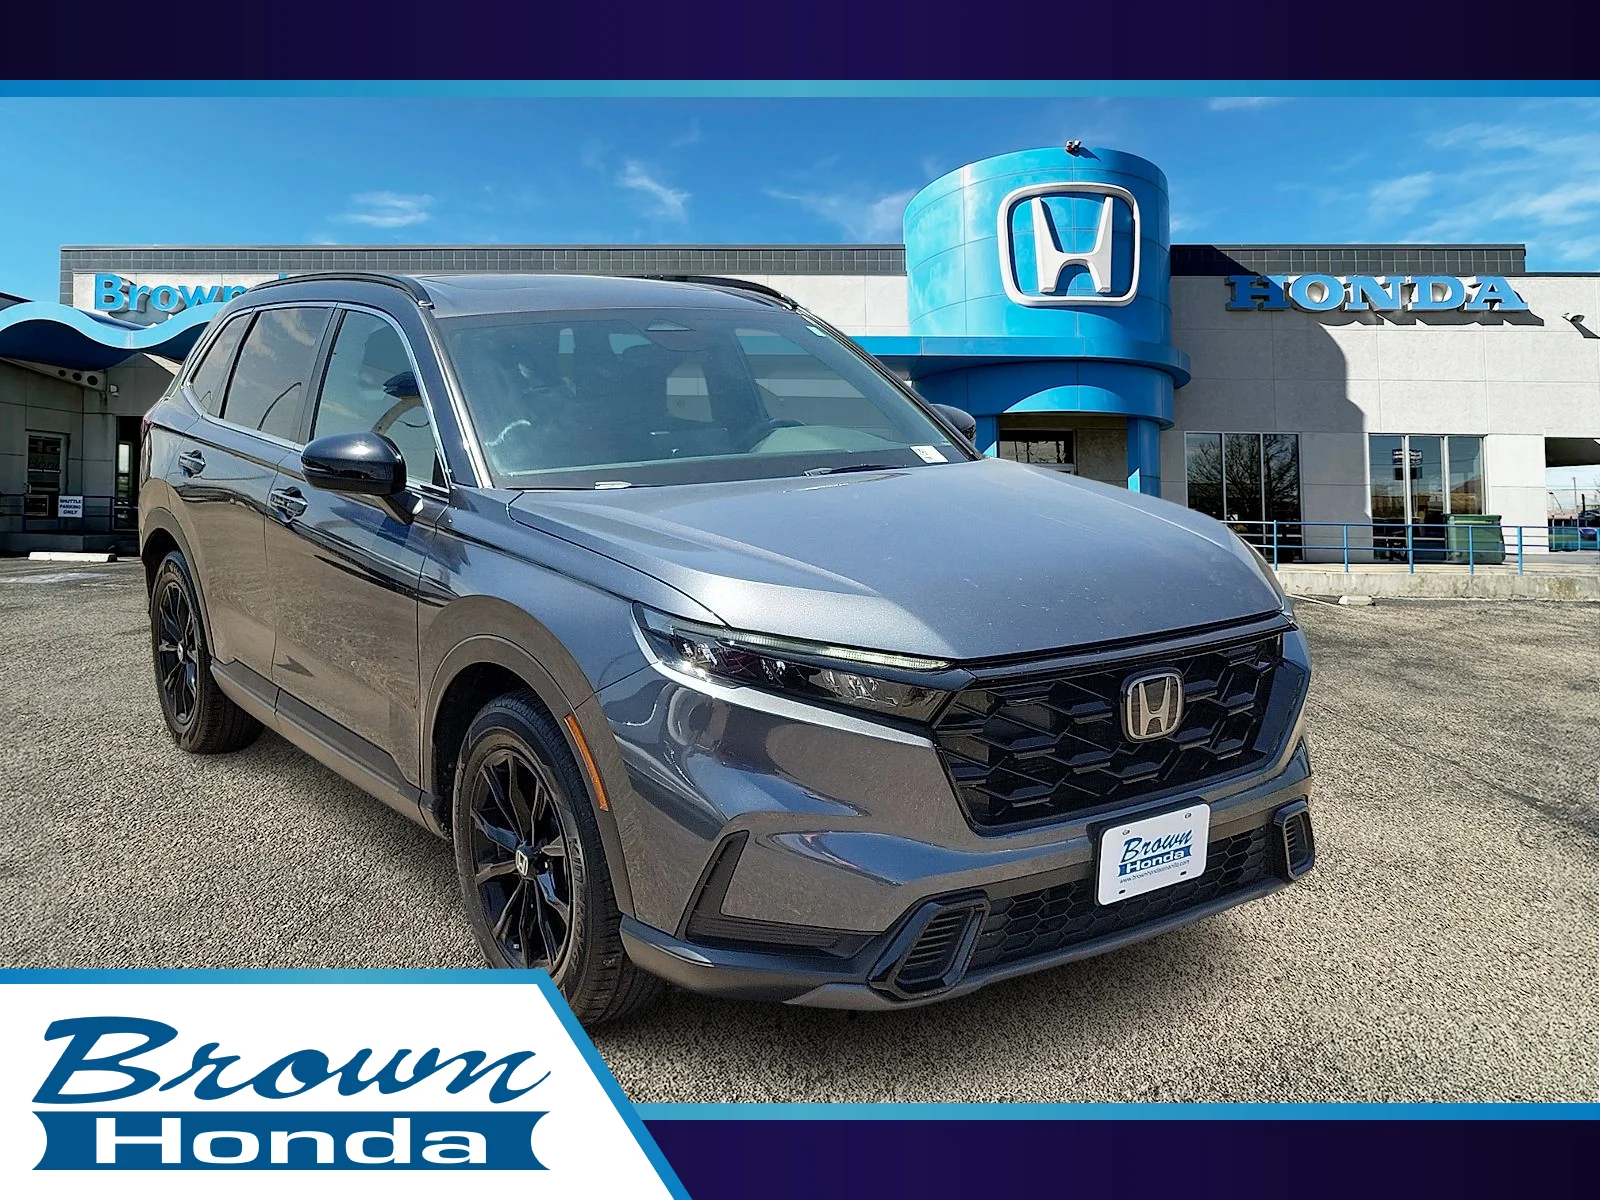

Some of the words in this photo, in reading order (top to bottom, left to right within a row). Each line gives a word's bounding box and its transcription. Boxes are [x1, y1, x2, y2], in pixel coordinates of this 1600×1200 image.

[1031, 196, 1113, 293] H
[1225, 274, 1529, 312] HONDA
[1121, 829, 1192, 863] Brown
[1126, 849, 1185, 874] Honda
